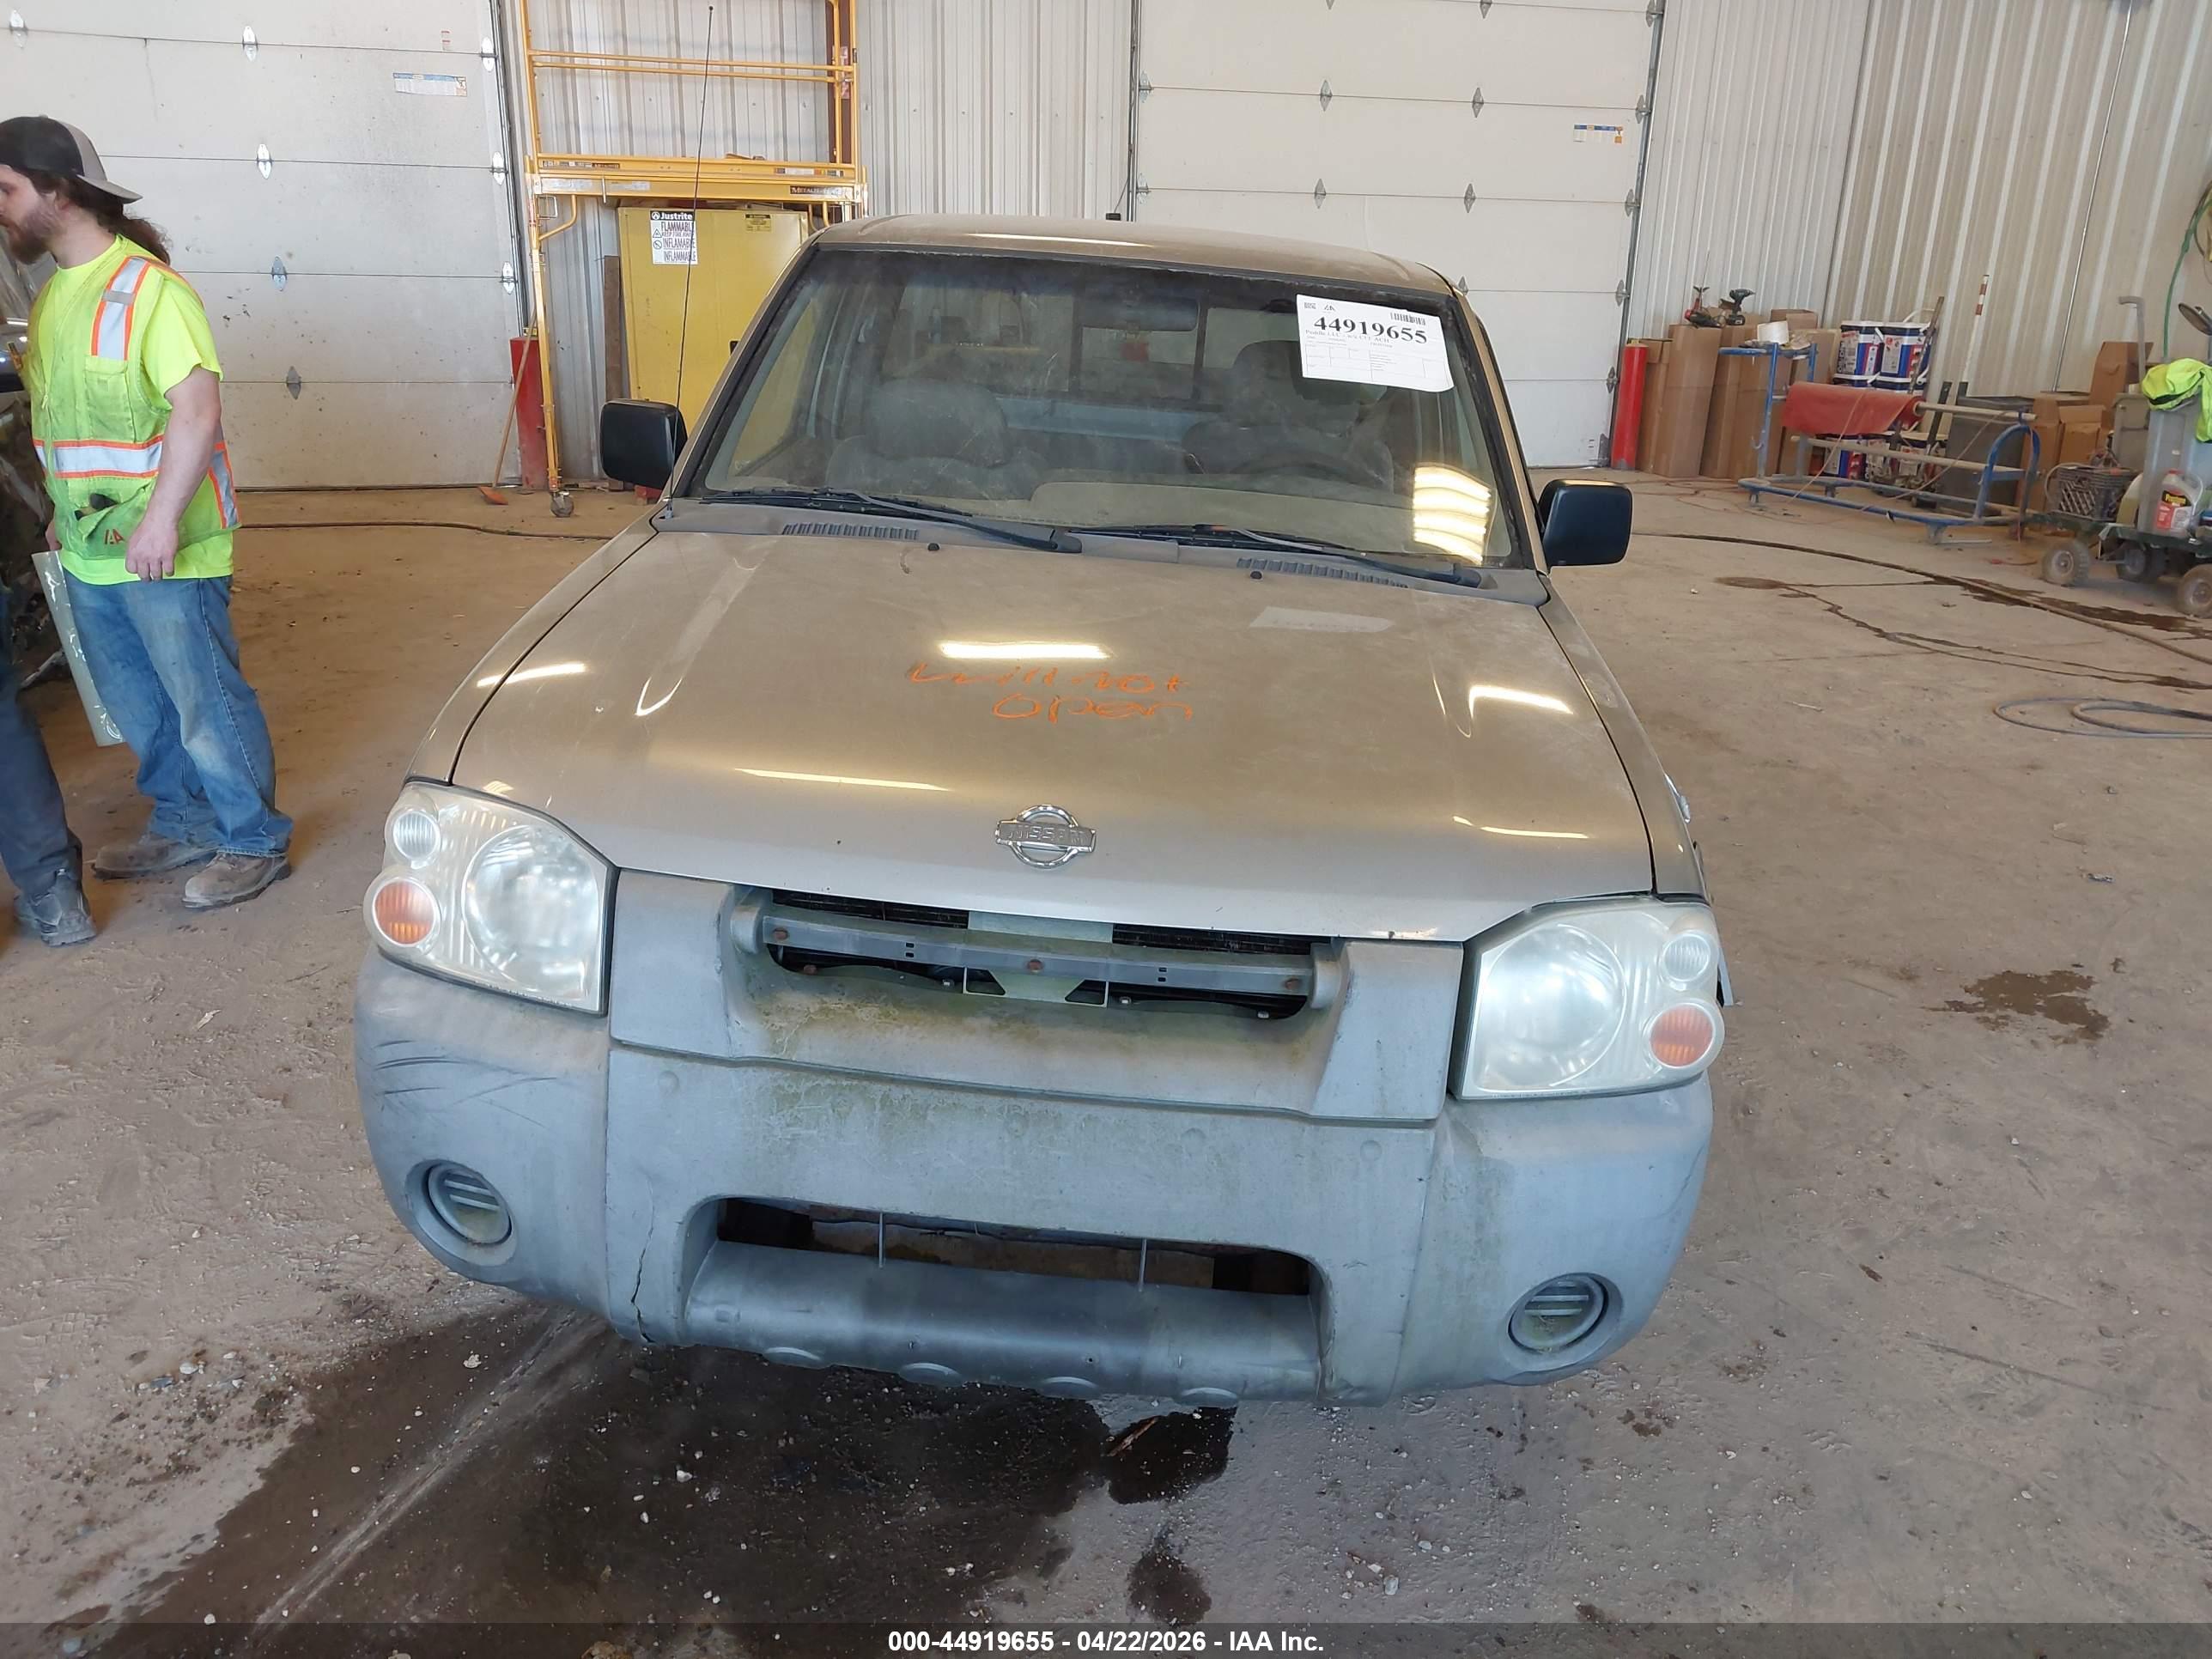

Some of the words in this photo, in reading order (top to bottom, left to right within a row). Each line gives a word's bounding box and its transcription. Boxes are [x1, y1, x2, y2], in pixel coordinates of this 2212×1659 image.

[661, 222, 694, 232] FLAMMABL
[663, 238, 696, 248] INFLAMABE
[664, 251, 696, 261] INFLAMMALE
[1314, 316, 1427, 343] 44919655
[1007, 824, 1085, 843] NISSAN
